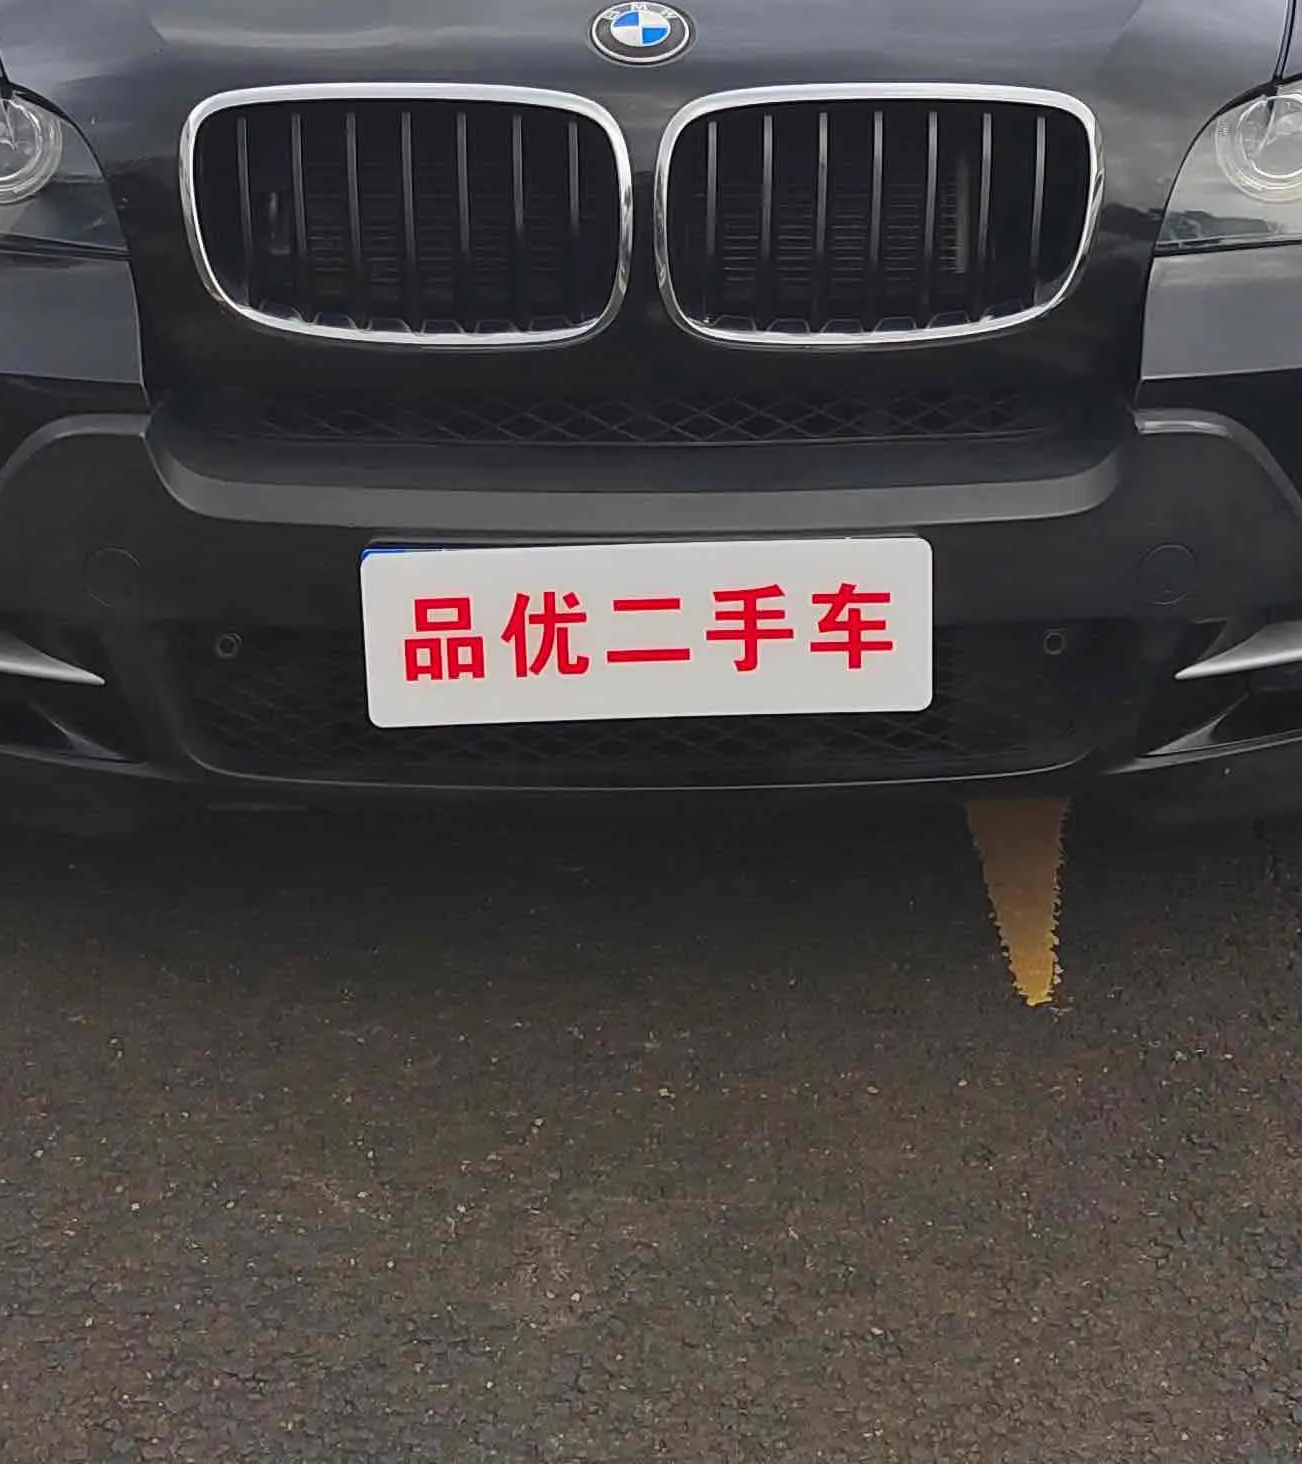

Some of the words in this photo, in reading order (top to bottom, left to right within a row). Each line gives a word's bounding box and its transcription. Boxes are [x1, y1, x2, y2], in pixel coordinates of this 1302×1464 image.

[403, 582, 895, 682] 品优二手车
